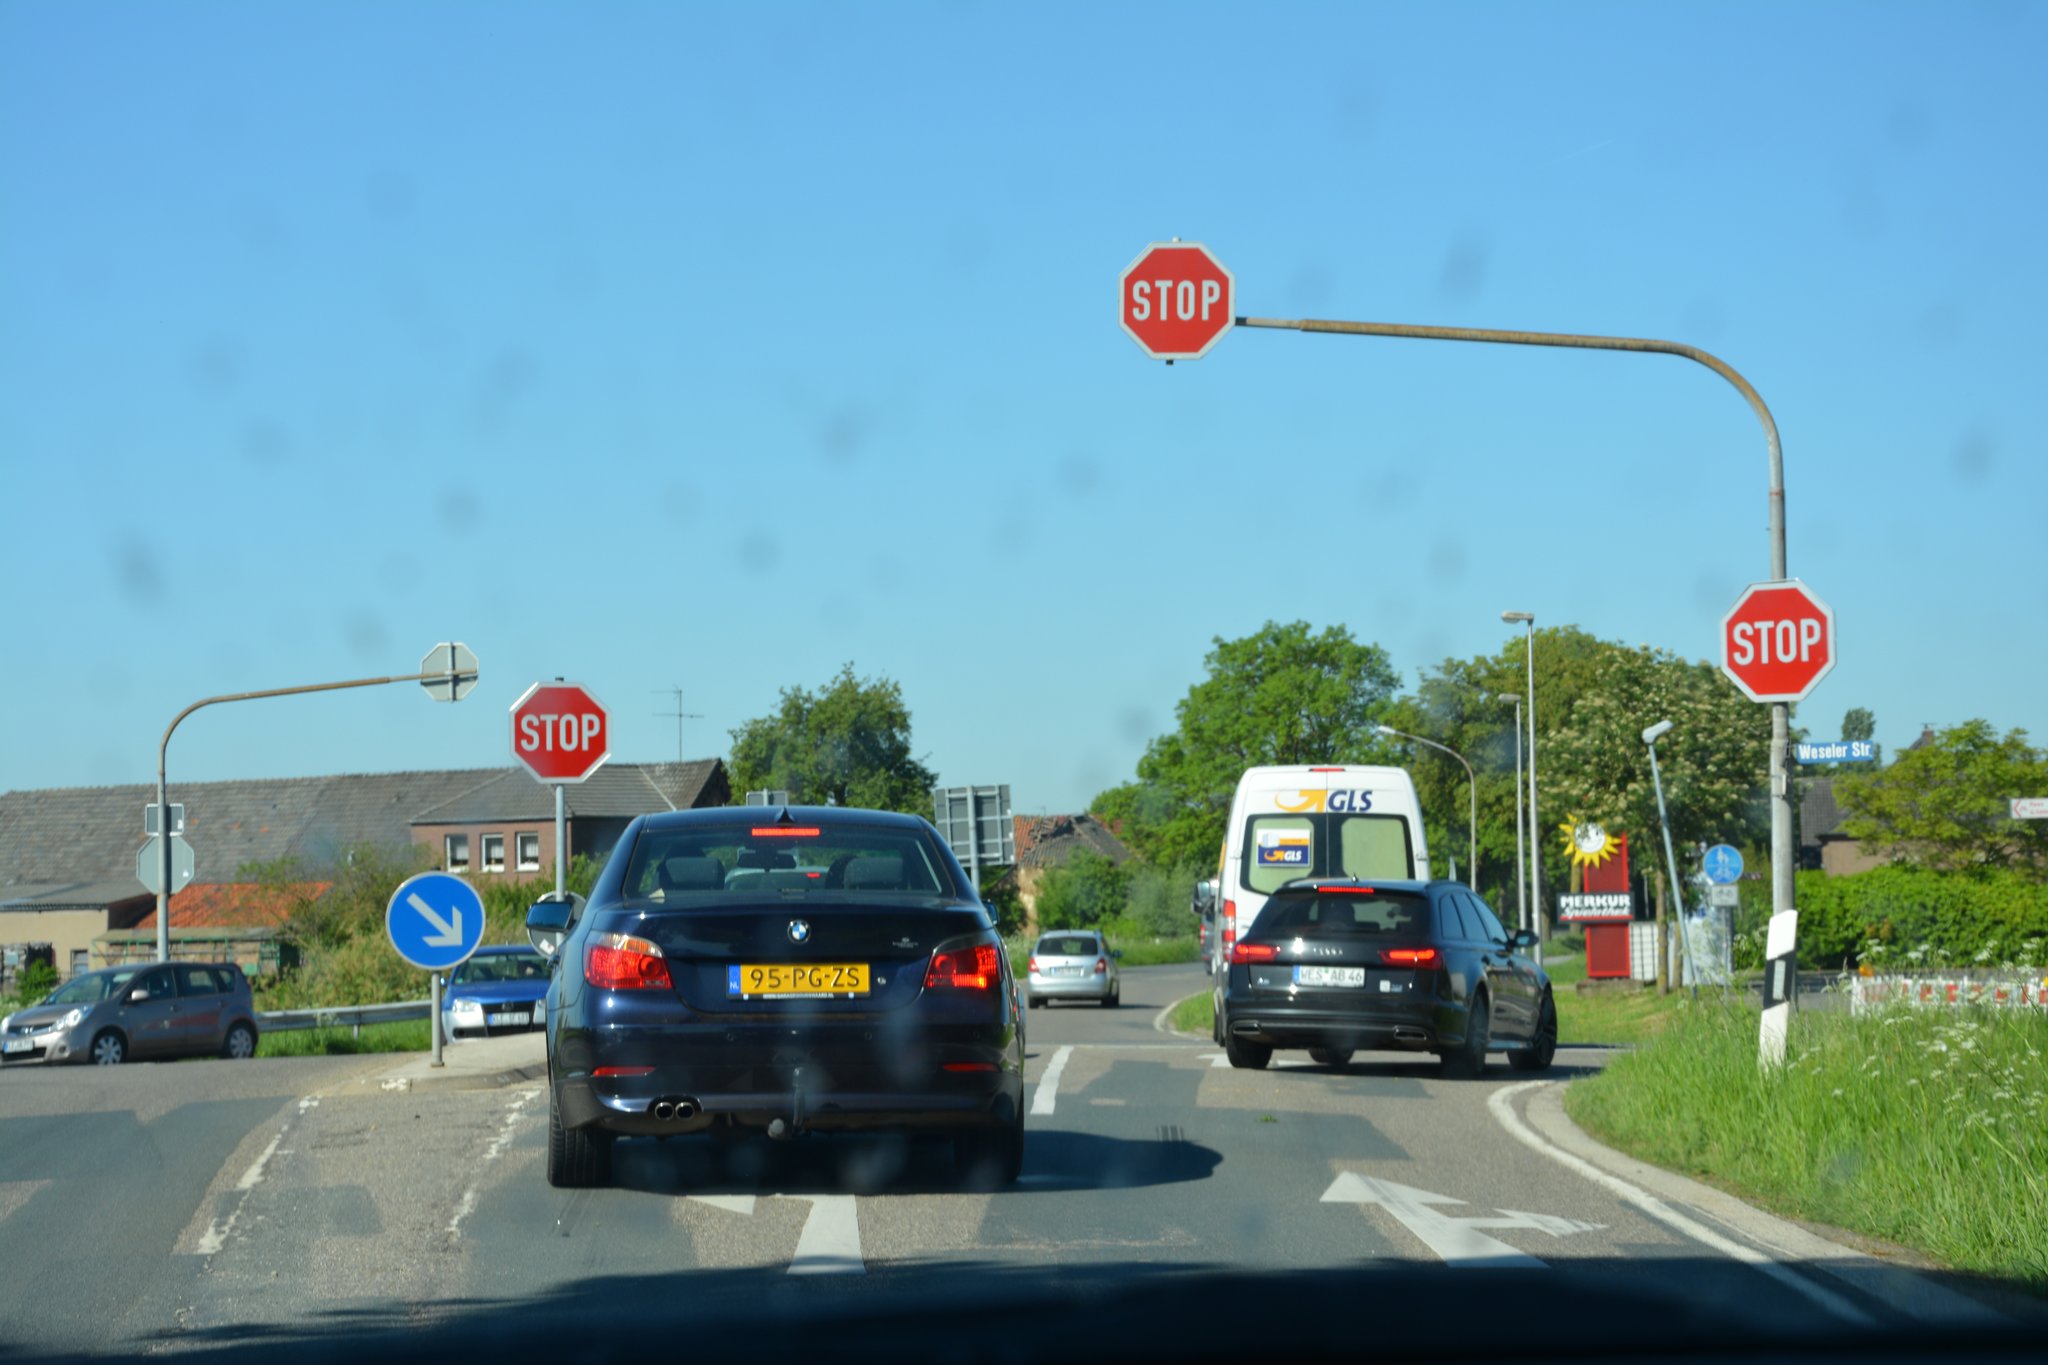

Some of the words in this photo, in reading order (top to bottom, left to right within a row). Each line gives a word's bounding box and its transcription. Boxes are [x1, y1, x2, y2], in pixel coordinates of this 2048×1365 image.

[1132, 280, 1221, 321] STOP
[1732, 618, 1821, 666] STOP
[520, 713, 601, 752] STOP
[1798, 743, 1848, 760] Weseler
[1328, 789, 1373, 812] GLS
[1284, 849, 1303, 862] GLS
[1560, 894, 1631, 909] MERKUR
[750, 967, 860, 989] 95-PG-ZS
